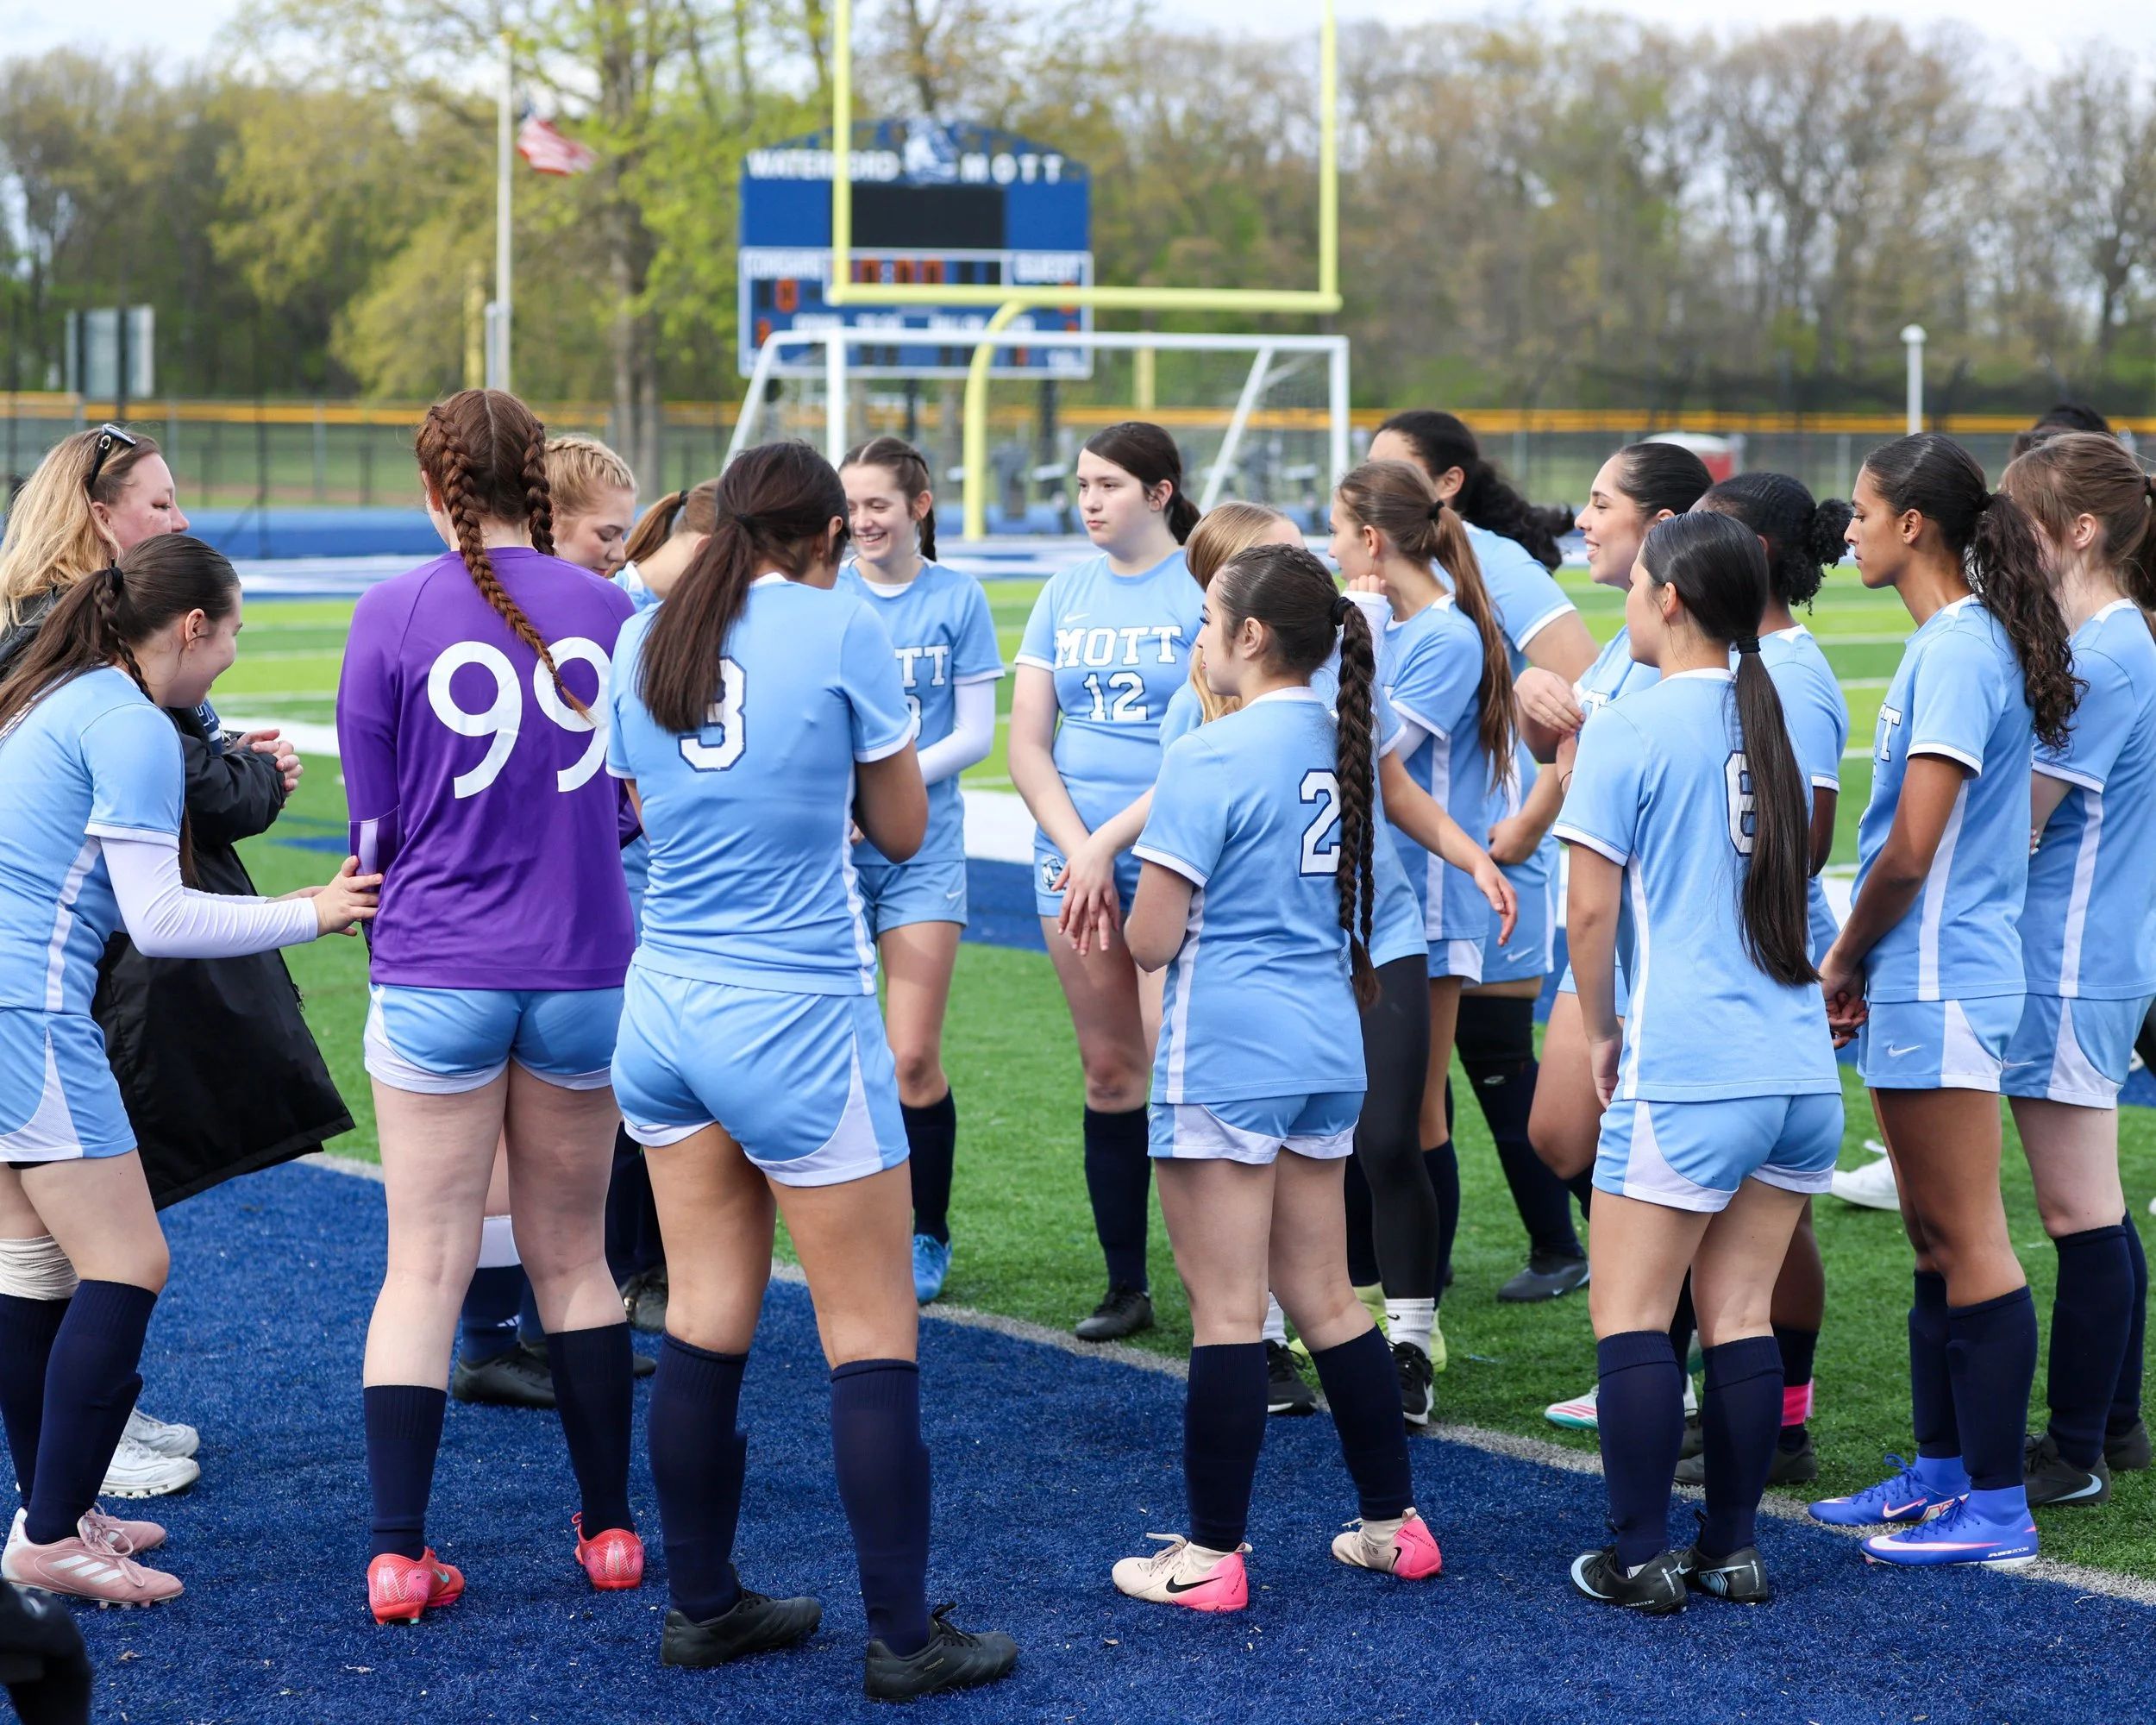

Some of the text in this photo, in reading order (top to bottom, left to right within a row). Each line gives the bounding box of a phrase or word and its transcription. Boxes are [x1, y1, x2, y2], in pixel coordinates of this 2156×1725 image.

[960, 153, 1063, 185] MOTT
[1055, 625, 1182, 670] MOTT
[428, 637, 610, 799] 99
[677, 655, 748, 773] 3
[1082, 671, 1149, 721] 12
[1299, 768, 1342, 877] 2
